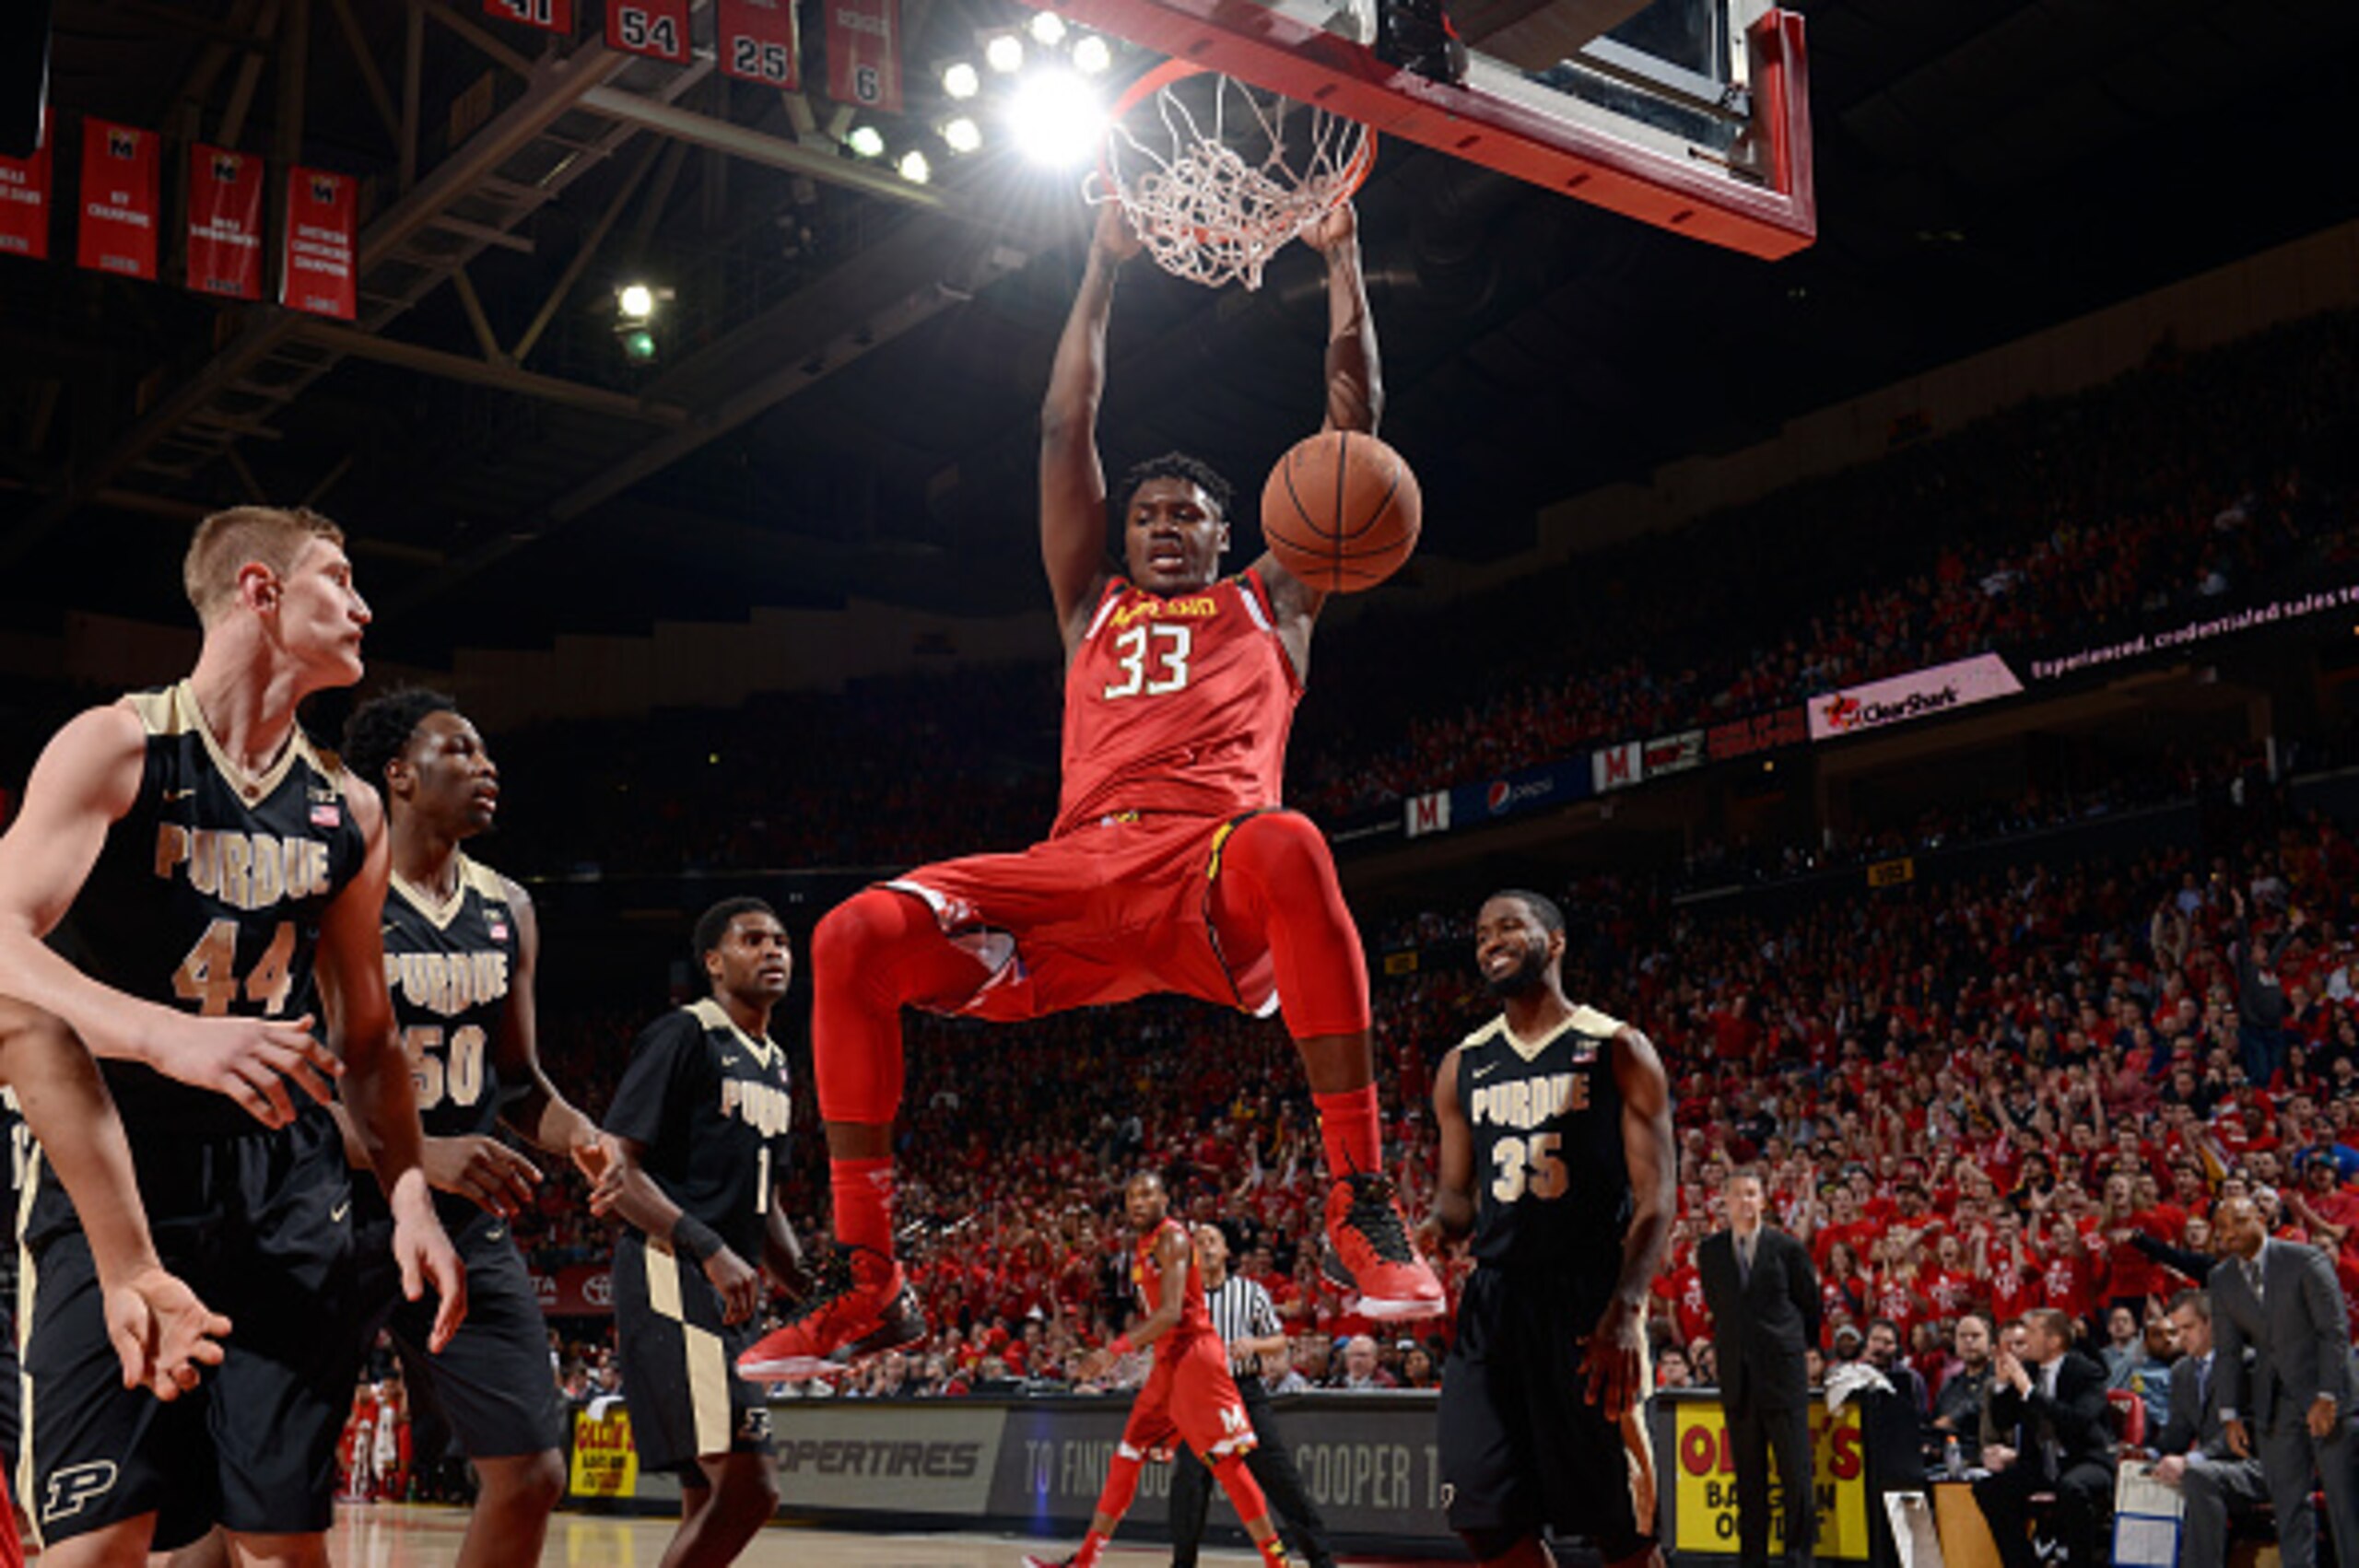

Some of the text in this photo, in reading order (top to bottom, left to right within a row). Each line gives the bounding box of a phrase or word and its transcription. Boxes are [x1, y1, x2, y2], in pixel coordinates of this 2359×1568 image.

[620, 9, 676, 53] 54
[734, 36, 788, 82] 25
[854, 64, 882, 104] 6
[2283, 592, 2337, 618] sales
[1104, 623, 1191, 699] 33
[1864, 685, 1957, 723] ClearShark
[1605, 744, 1630, 783] M
[154, 821, 331, 910] PURDUE
[171, 918, 297, 1016] 44
[382, 952, 509, 1016] PURDUE
[404, 1024, 487, 1110] 50
[1471, 1071, 1590, 1130] PURDUE
[756, 1145, 771, 1214] 1
[1492, 1131, 1568, 1203] 35
[1218, 1403, 1249, 1433] M
[775, 1439, 984, 1479] OPERTIRES
[1025, 1439, 1055, 1494] TO
[1296, 1443, 1411, 1509] COOPER
[42, 1459, 119, 1524] P
